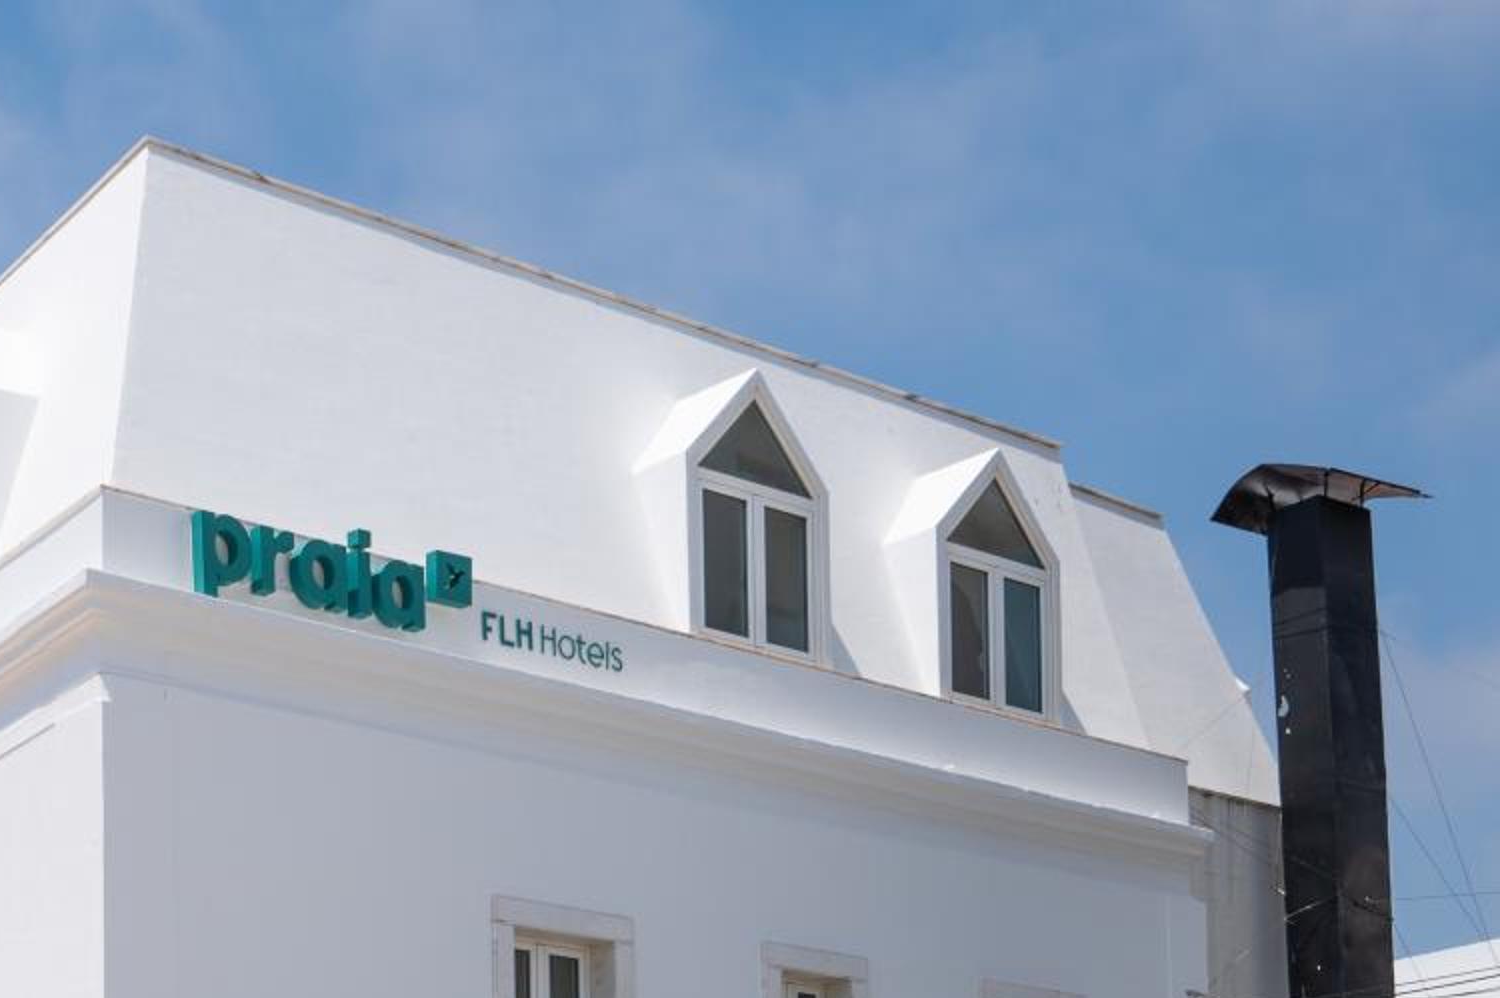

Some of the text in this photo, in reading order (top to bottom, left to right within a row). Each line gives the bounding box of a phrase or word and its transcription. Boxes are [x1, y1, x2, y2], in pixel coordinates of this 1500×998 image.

[192, 510, 426, 632] praia
[481, 610, 624, 673] FLH Hotels
